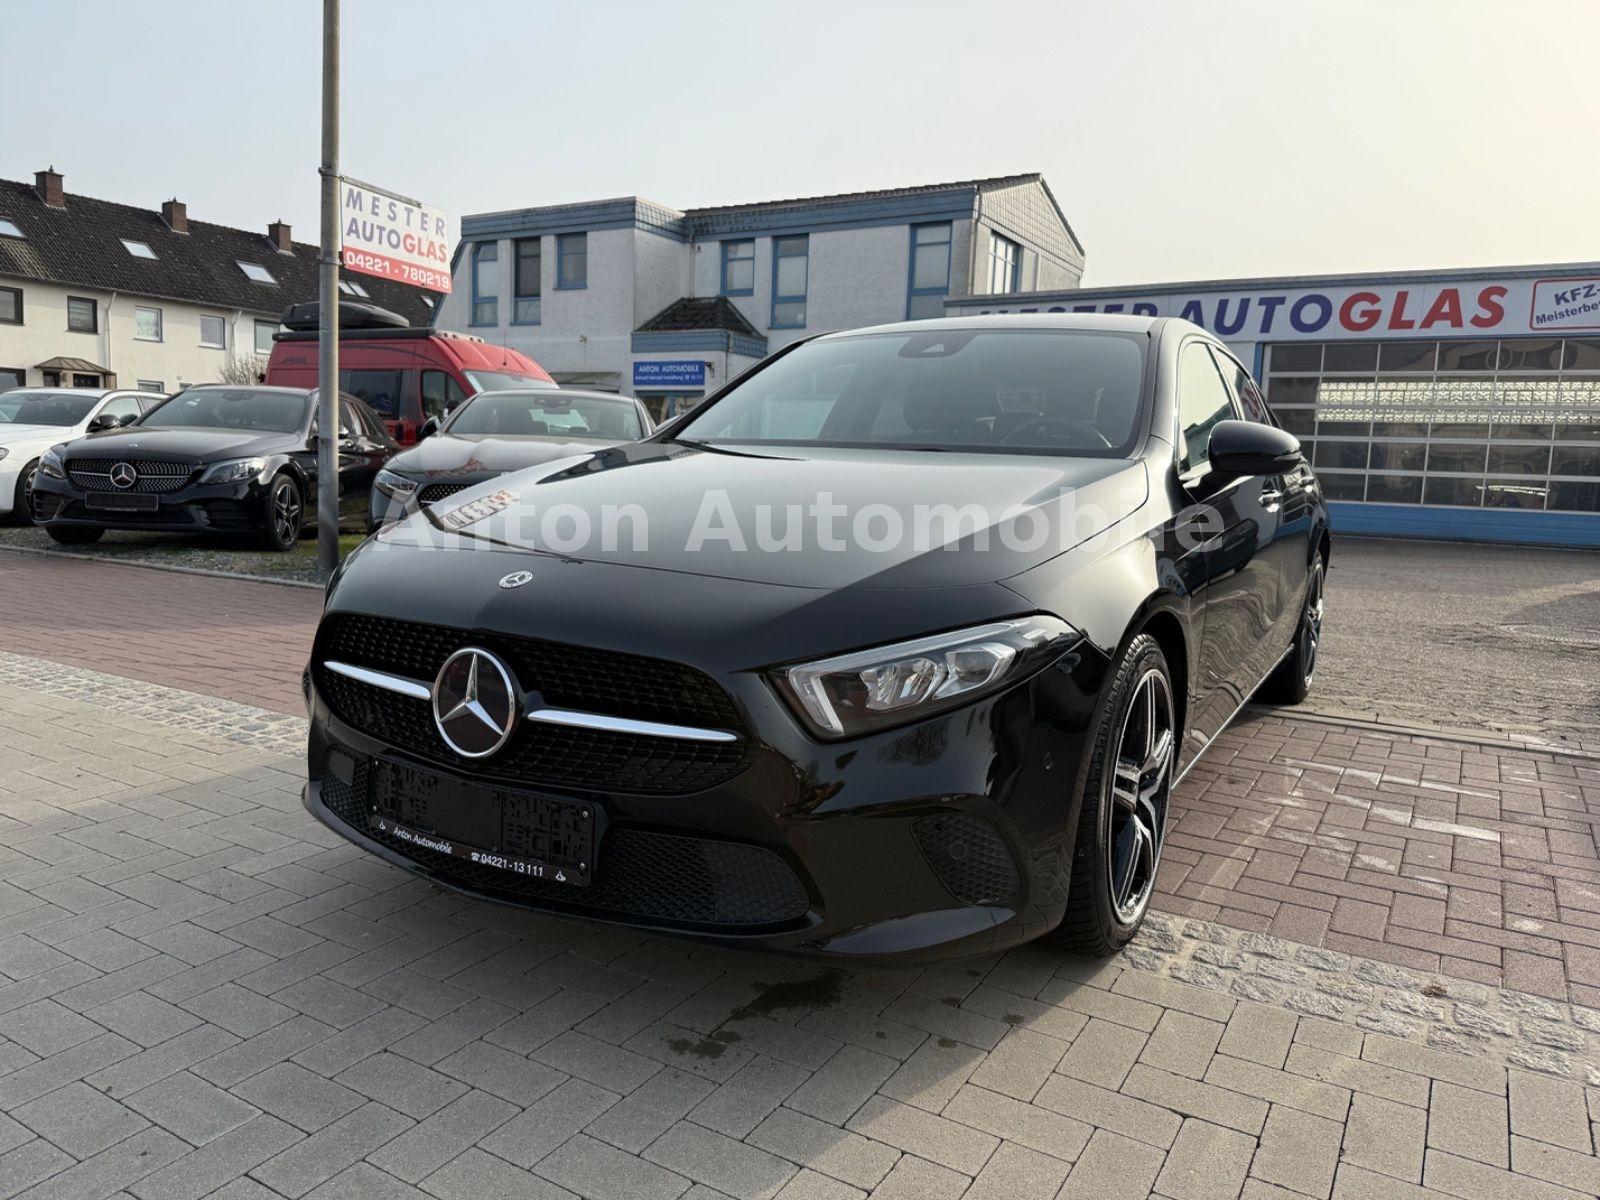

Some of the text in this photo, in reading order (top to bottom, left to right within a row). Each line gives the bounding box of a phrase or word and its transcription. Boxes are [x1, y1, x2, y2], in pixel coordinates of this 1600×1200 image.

[346, 188, 446, 237] MESTER
[346, 217, 447, 264] AUTOGLAS
[346, 252, 391, 274] 04221
[401, 265, 449, 289] 780219
[1180, 286, 1508, 336] AUTOGLAS
[639, 364, 699, 373] ANTON AUTOMOBILE
[393, 826, 453, 855] Anton Automobile
